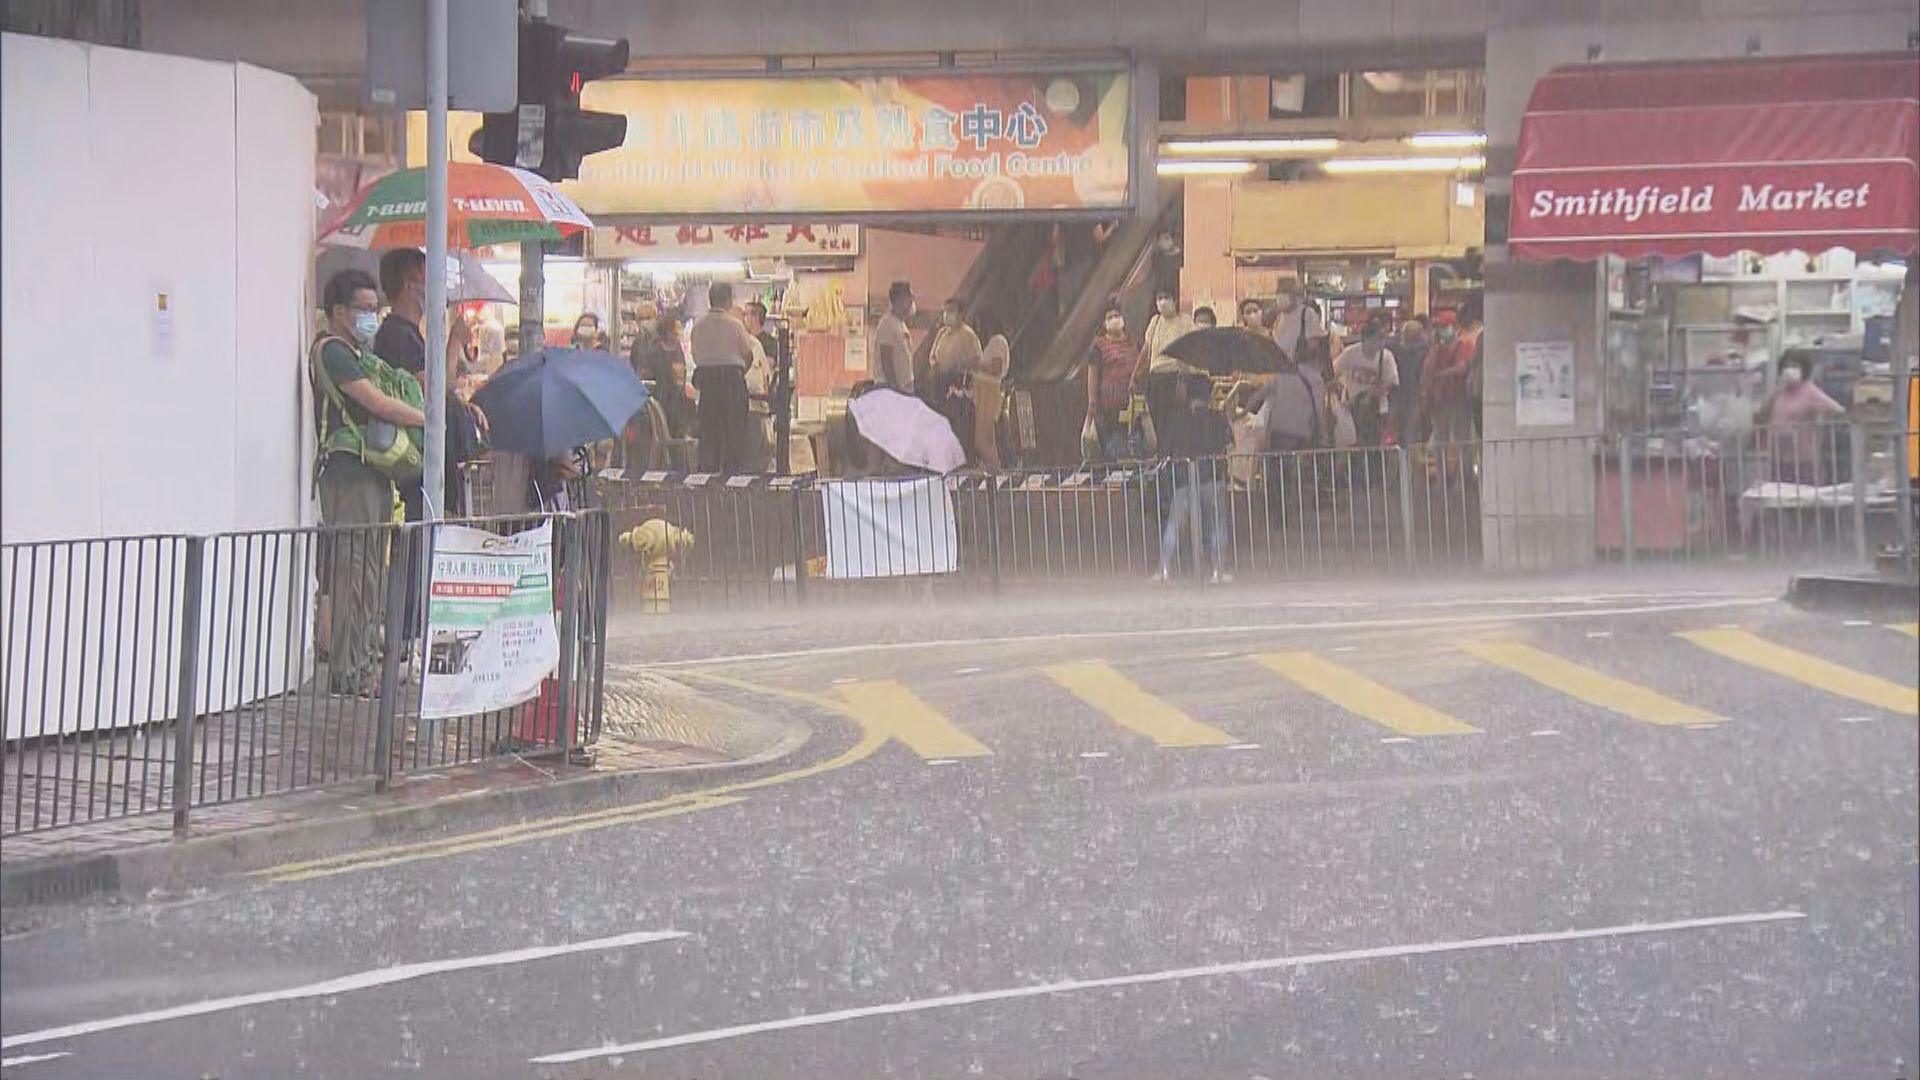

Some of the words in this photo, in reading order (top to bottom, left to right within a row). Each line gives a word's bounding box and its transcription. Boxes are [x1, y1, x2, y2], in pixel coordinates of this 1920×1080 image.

[935, 152, 1000, 178] Food
[1006, 151, 1093, 176] Centre
[1530, 185, 1714, 221] Smithfield
[1738, 182, 1870, 213] Market
